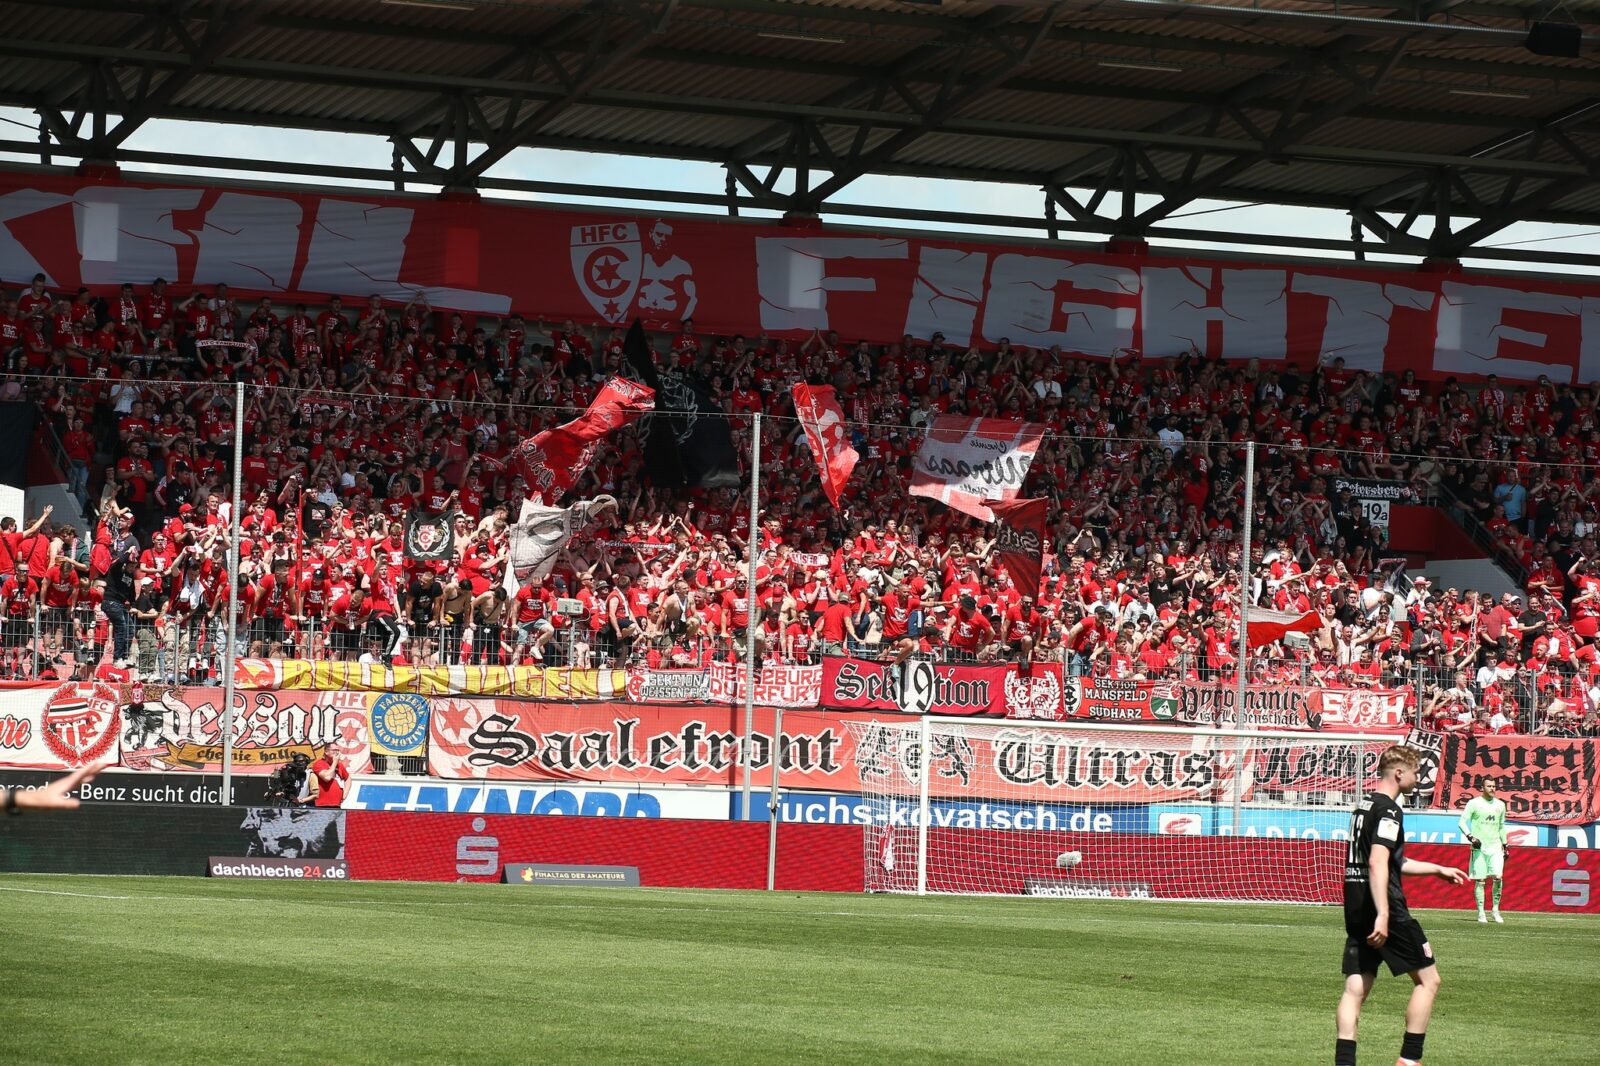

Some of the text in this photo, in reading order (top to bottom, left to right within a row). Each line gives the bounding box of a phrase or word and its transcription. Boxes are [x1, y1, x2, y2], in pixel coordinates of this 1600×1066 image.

[580, 223, 628, 243] HFC
[755, 236, 1600, 388] FIGHTE
[1363, 502, 1388, 521] 19a
[1094, 678, 1138, 690] SEKTION
[1084, 688, 1148, 701] MANSFELD
[1089, 704, 1142, 719] SÜDHARZ
[1221, 710, 1301, 726] Ledenschaft
[468, 713, 844, 777] Saalefront
[132, 785, 184, 802] sucht
[212, 861, 345, 879] dachbleche24.de
